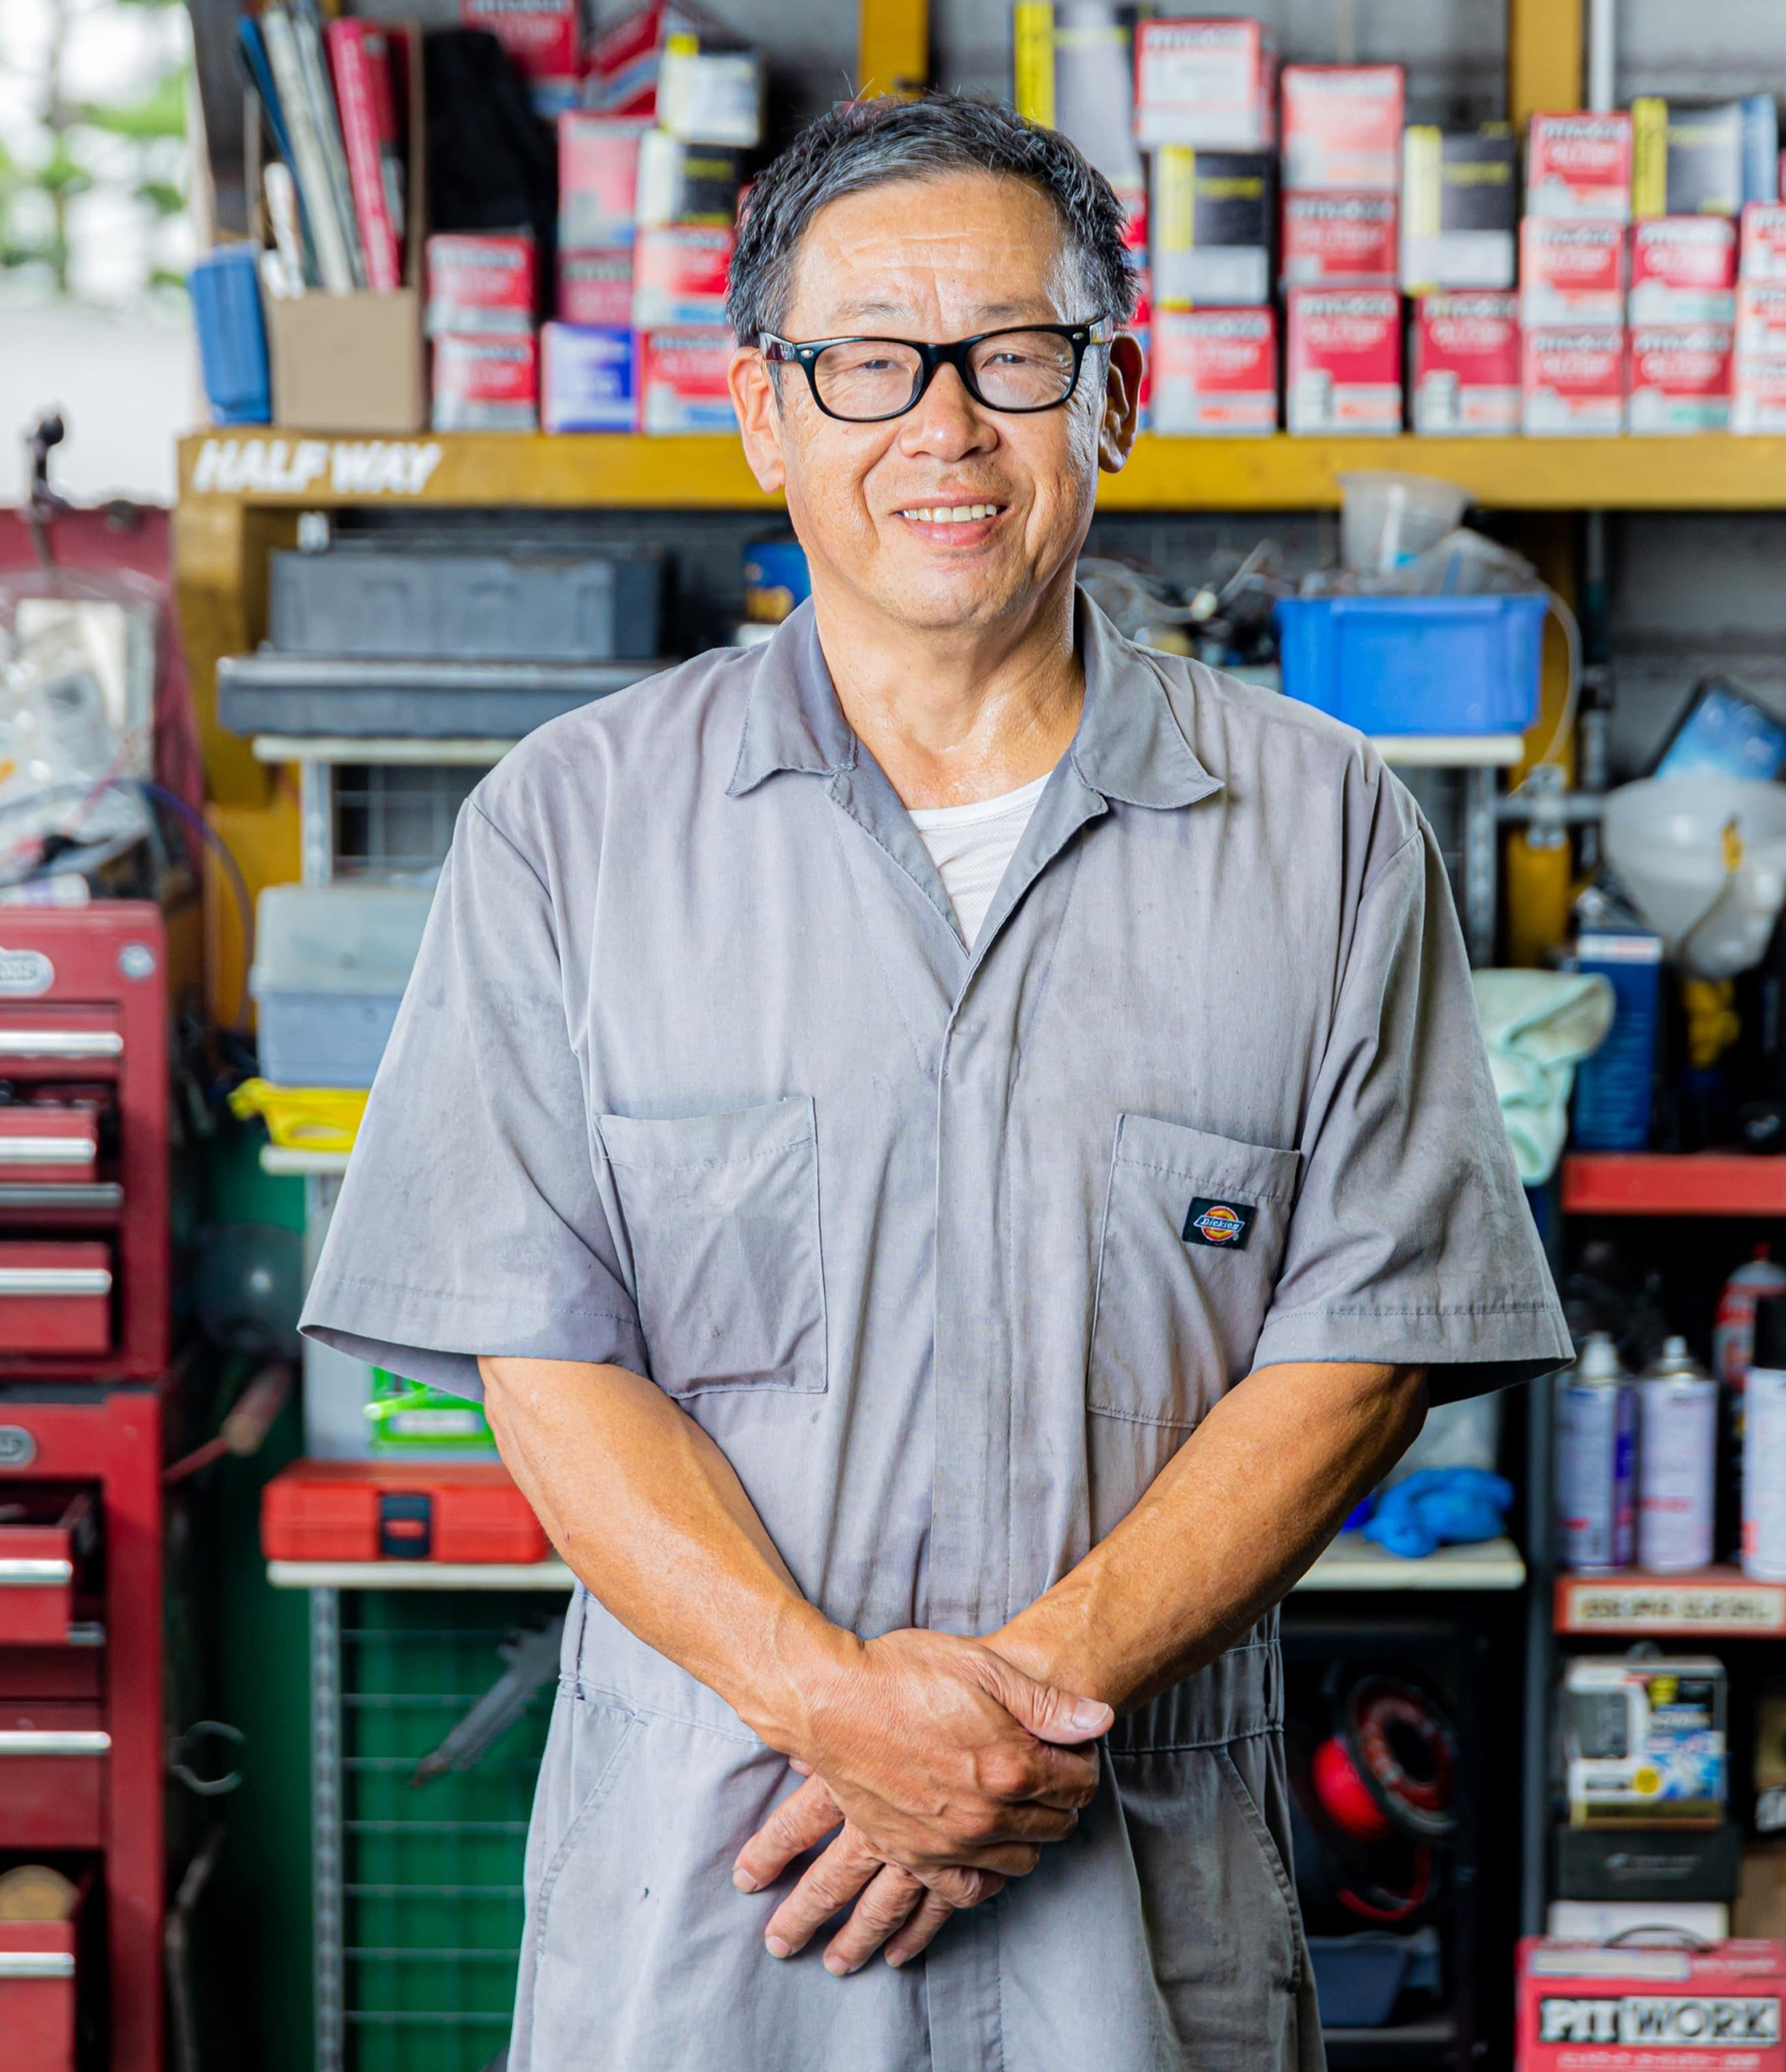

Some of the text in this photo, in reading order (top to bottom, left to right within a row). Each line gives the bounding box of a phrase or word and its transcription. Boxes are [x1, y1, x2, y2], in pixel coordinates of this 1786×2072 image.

[194, 439, 443, 494] HALF WAY
[1200, 1217, 1239, 1230] Dickies
